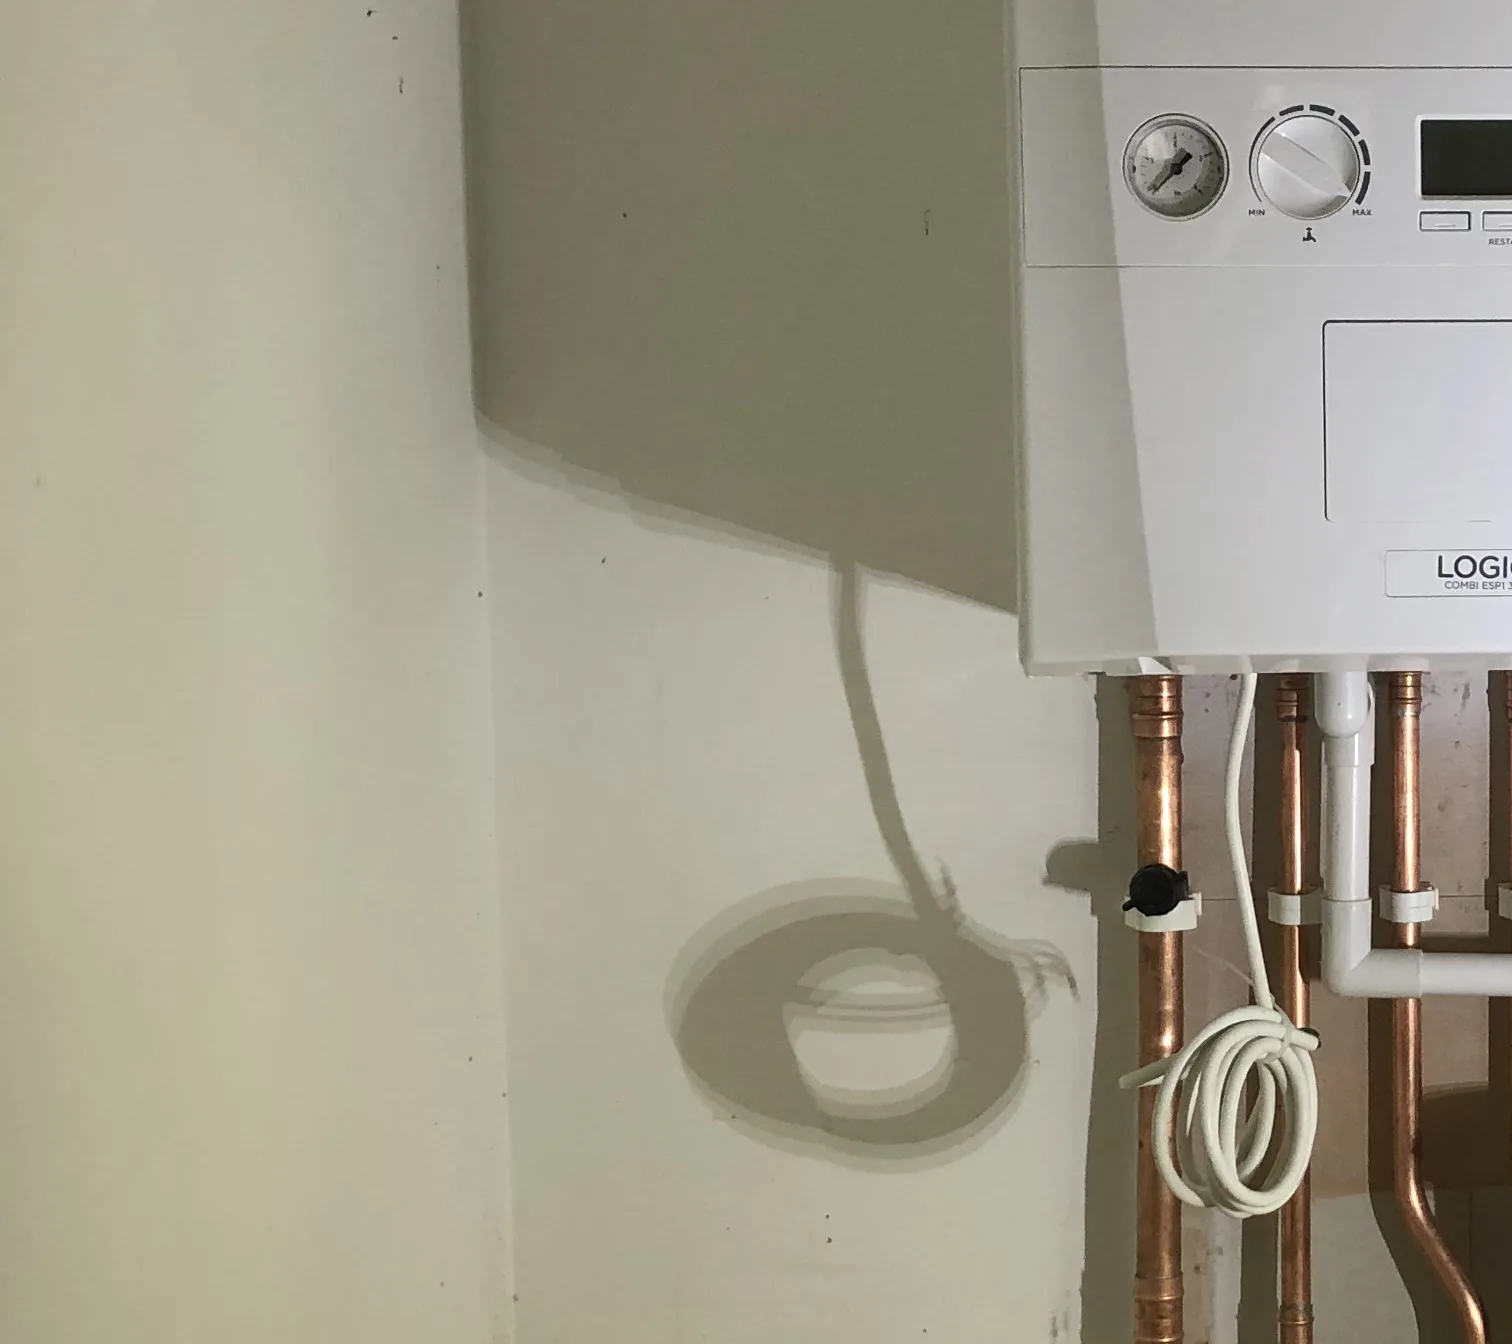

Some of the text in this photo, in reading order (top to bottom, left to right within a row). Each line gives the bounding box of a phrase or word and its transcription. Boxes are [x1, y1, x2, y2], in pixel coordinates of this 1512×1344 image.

[1248, 208, 1266, 216] MIN
[1352, 208, 1372, 216] MAX
[1444, 580, 1479, 590] COMBI
[1481, 581, 1505, 590] ESP1
